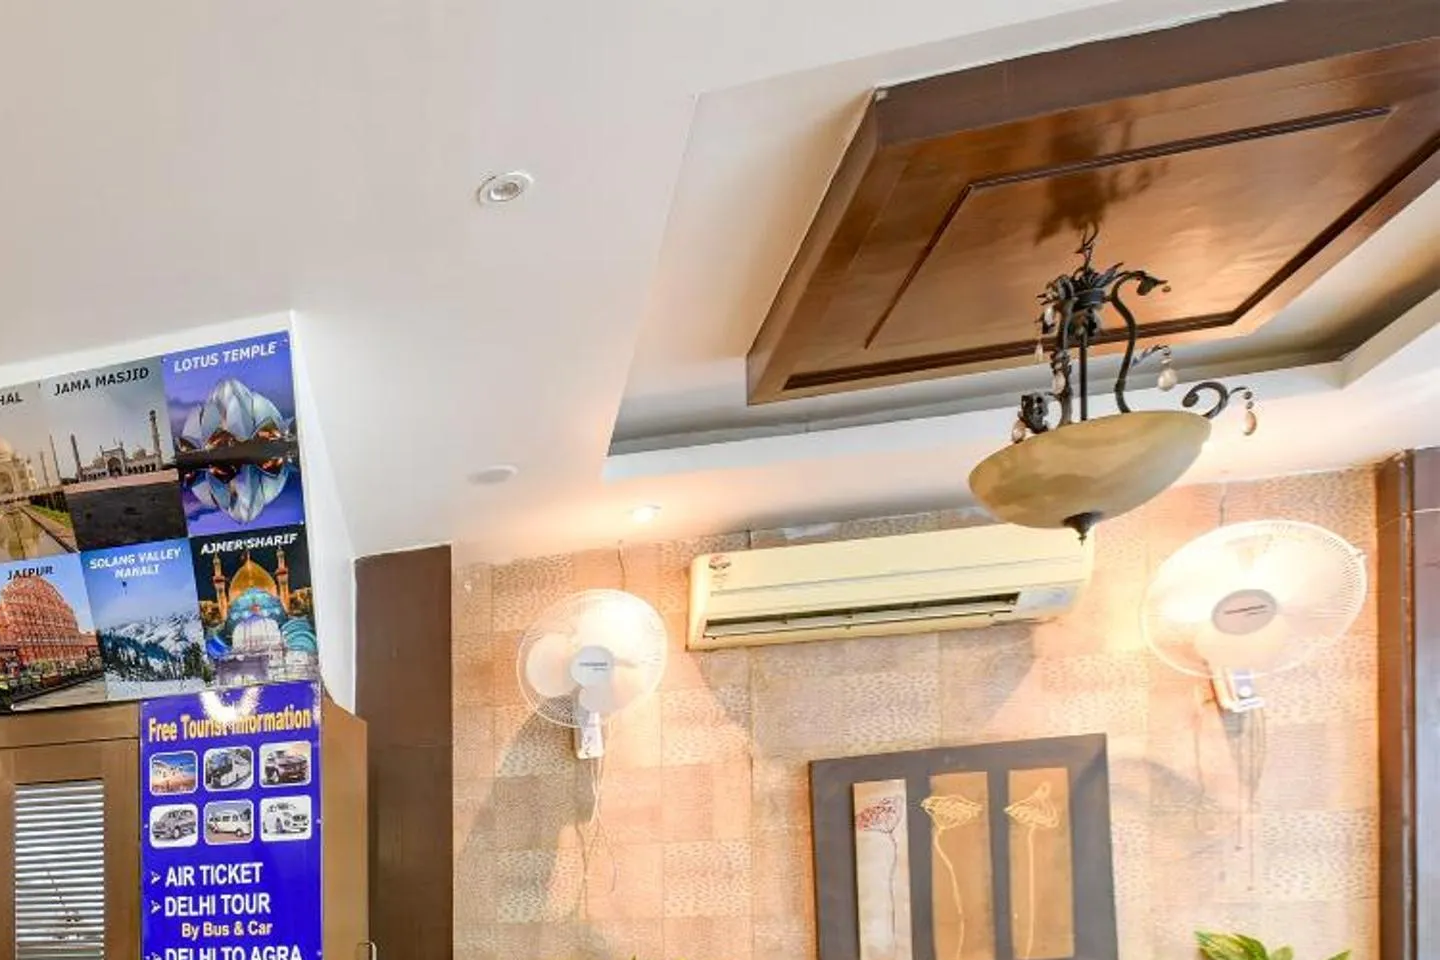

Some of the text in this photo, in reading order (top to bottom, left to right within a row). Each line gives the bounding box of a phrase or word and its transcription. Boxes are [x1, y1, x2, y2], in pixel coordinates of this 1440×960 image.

[174, 341, 278, 373] LOTUS TEMPLE
[54, 367, 150, 396] JAMA MASJID
[246, 532, 299, 549] SHARIF
[89, 547, 182, 570] SOLANG VALLEY
[7, 565, 54, 580] JAIPUR
[149, 717, 178, 742] Free
[180, 713, 228, 740] Tourist
[165, 862, 264, 888] AIR TICKET
[164, 892, 272, 918] DELHI TOUR
[181, 920, 273, 941] By Bus & Car
